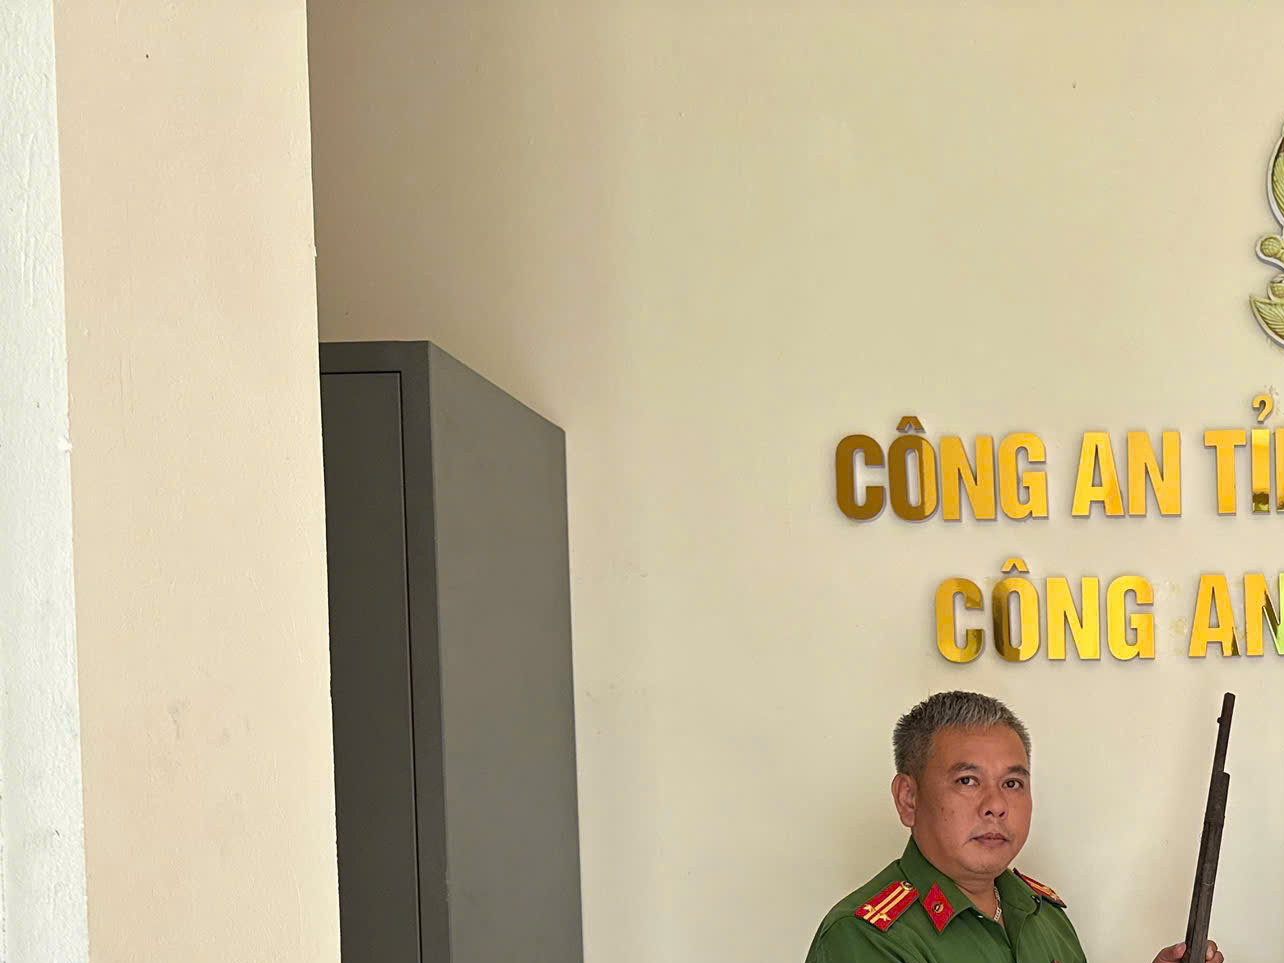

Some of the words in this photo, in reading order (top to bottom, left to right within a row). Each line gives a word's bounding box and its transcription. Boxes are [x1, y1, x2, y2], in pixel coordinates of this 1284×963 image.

[835, 415, 1049, 522] CÔNG
[1071, 431, 1183, 517] AN
[935, 557, 1156, 663] CÔNG
